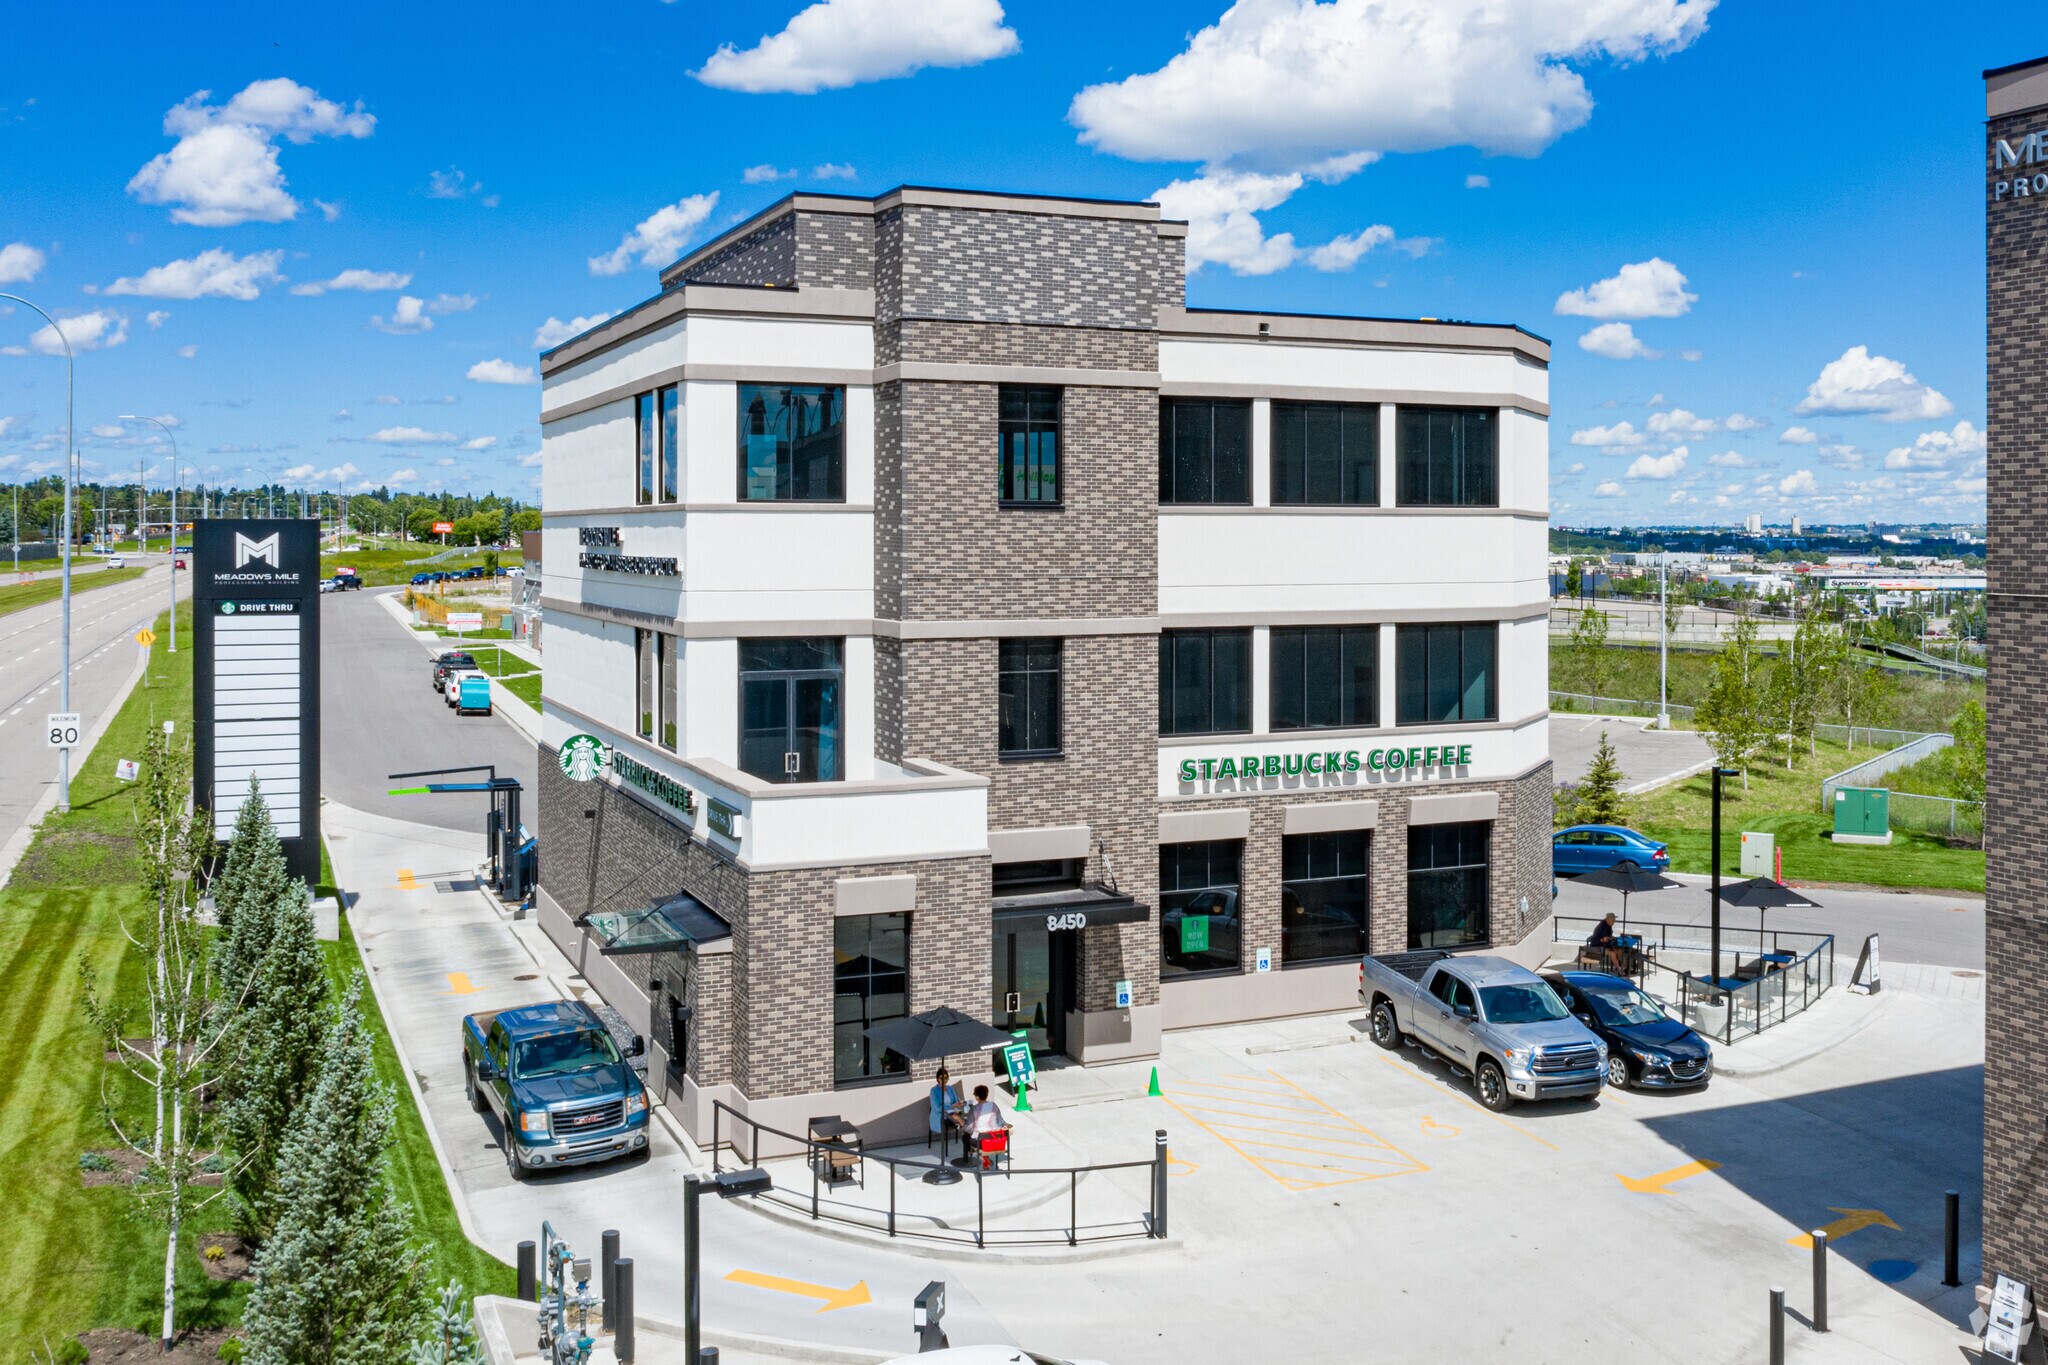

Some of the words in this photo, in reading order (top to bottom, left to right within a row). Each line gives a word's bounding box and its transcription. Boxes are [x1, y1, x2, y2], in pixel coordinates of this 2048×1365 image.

[1996, 173, 2048, 201] PRO
[240, 604, 266, 612] DRIVE
[269, 604, 293, 612] THRU
[50, 727, 78, 744] 80
[1180, 750, 1362, 782] STARBUCKS
[1368, 744, 1473, 771] COFFEE
[1046, 912, 1087, 931] 8450
[1187, 931, 1203, 940] NOW
[1186, 941, 1204, 949] OPEN
